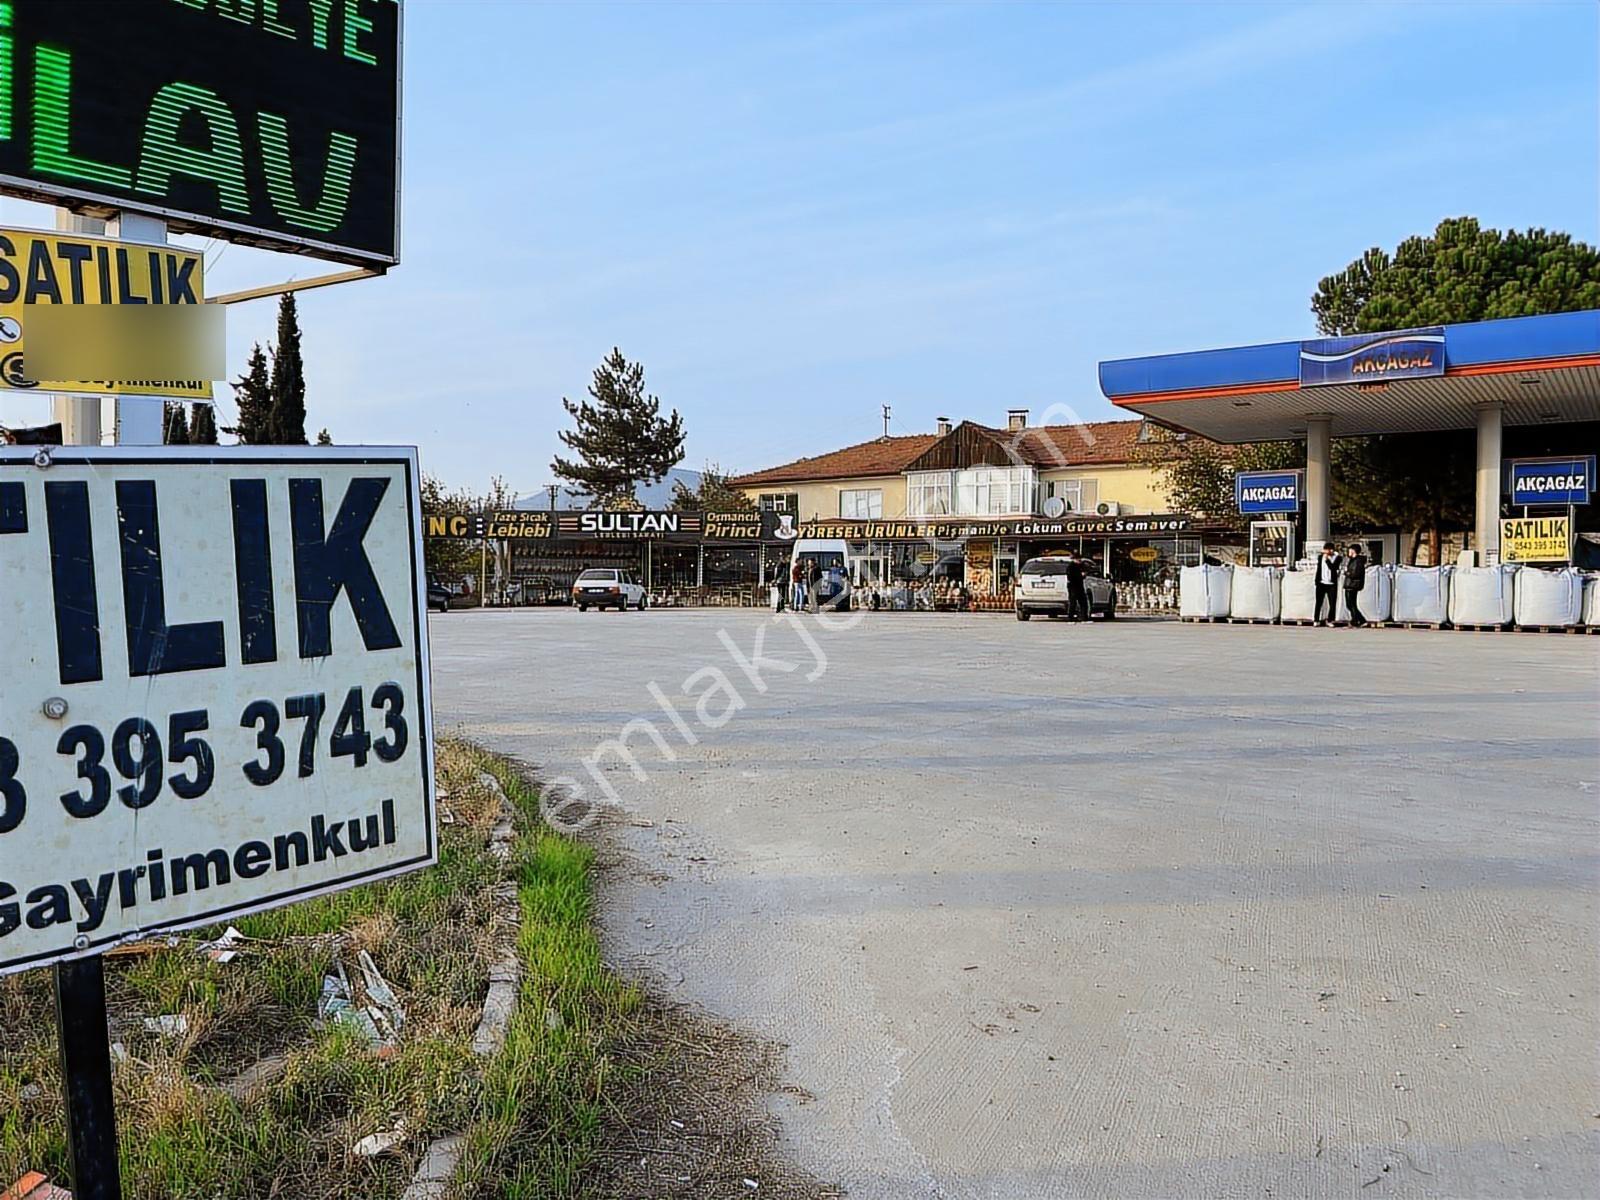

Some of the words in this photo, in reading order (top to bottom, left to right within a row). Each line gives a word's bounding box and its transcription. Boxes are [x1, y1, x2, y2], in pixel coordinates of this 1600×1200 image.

[0, 236, 200, 304] SATILIK
[1352, 348, 1436, 374] AKÇAGAZ
[1515, 475, 1585, 493] AKÇAGAZ
[1242, 486, 1296, 503] AKÇAGAZ
[492, 513, 517, 522] Taze
[581, 513, 678, 532] SULTAN
[487, 523, 551, 538] Leblebi
[704, 523, 763, 538] Pirinci
[797, 524, 862, 539] YÖRESEL
[865, 522, 936, 538] ÜRÜNLER
[937, 523, 1007, 538] Pişmaniye
[1015, 522, 1062, 534] Lokum
[1115, 519, 1186, 532] Semaver
[1504, 520, 1566, 539] SATILIK
[56, 709, 215, 818] 395
[240, 681, 408, 786] 3743
